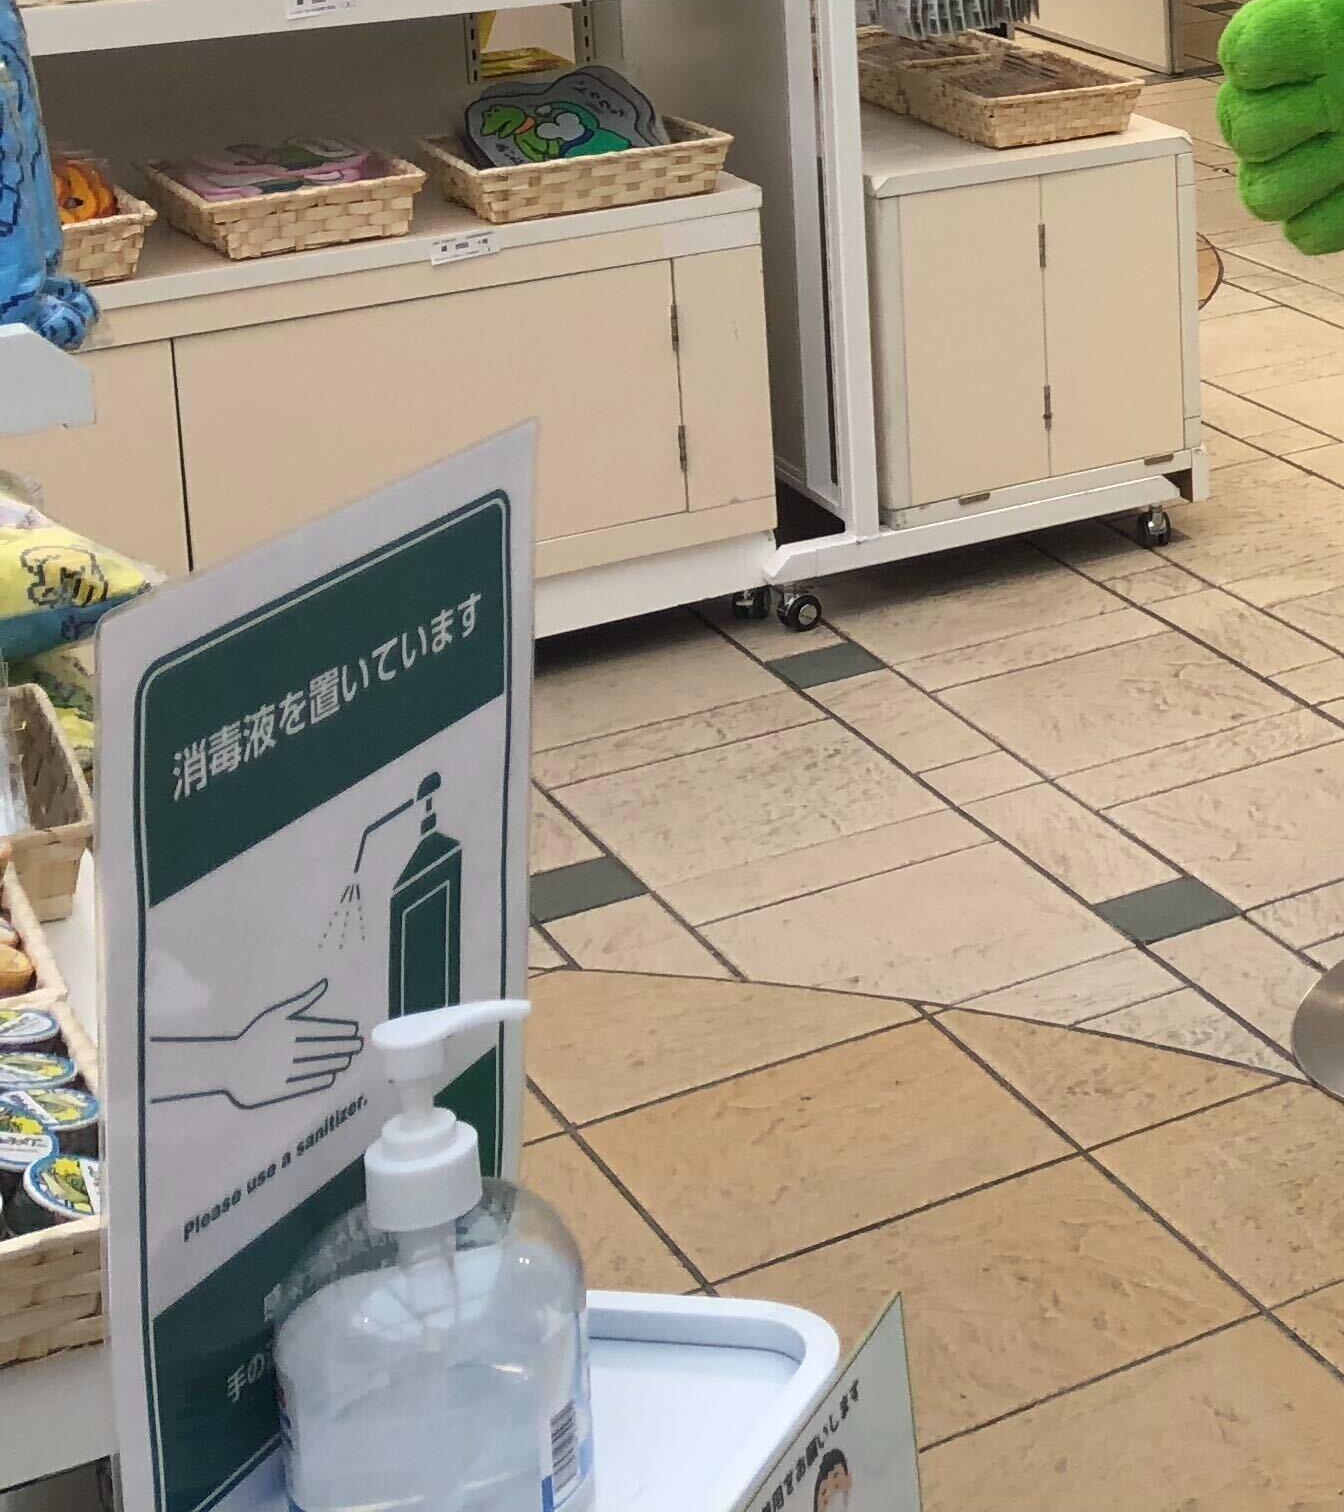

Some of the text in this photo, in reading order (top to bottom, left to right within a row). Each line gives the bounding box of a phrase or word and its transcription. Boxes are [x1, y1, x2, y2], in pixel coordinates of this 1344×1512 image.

[172, 592, 483, 802] 消毒液を置いています
[183, 1093, 368, 1243] Please use a sanitizer.
